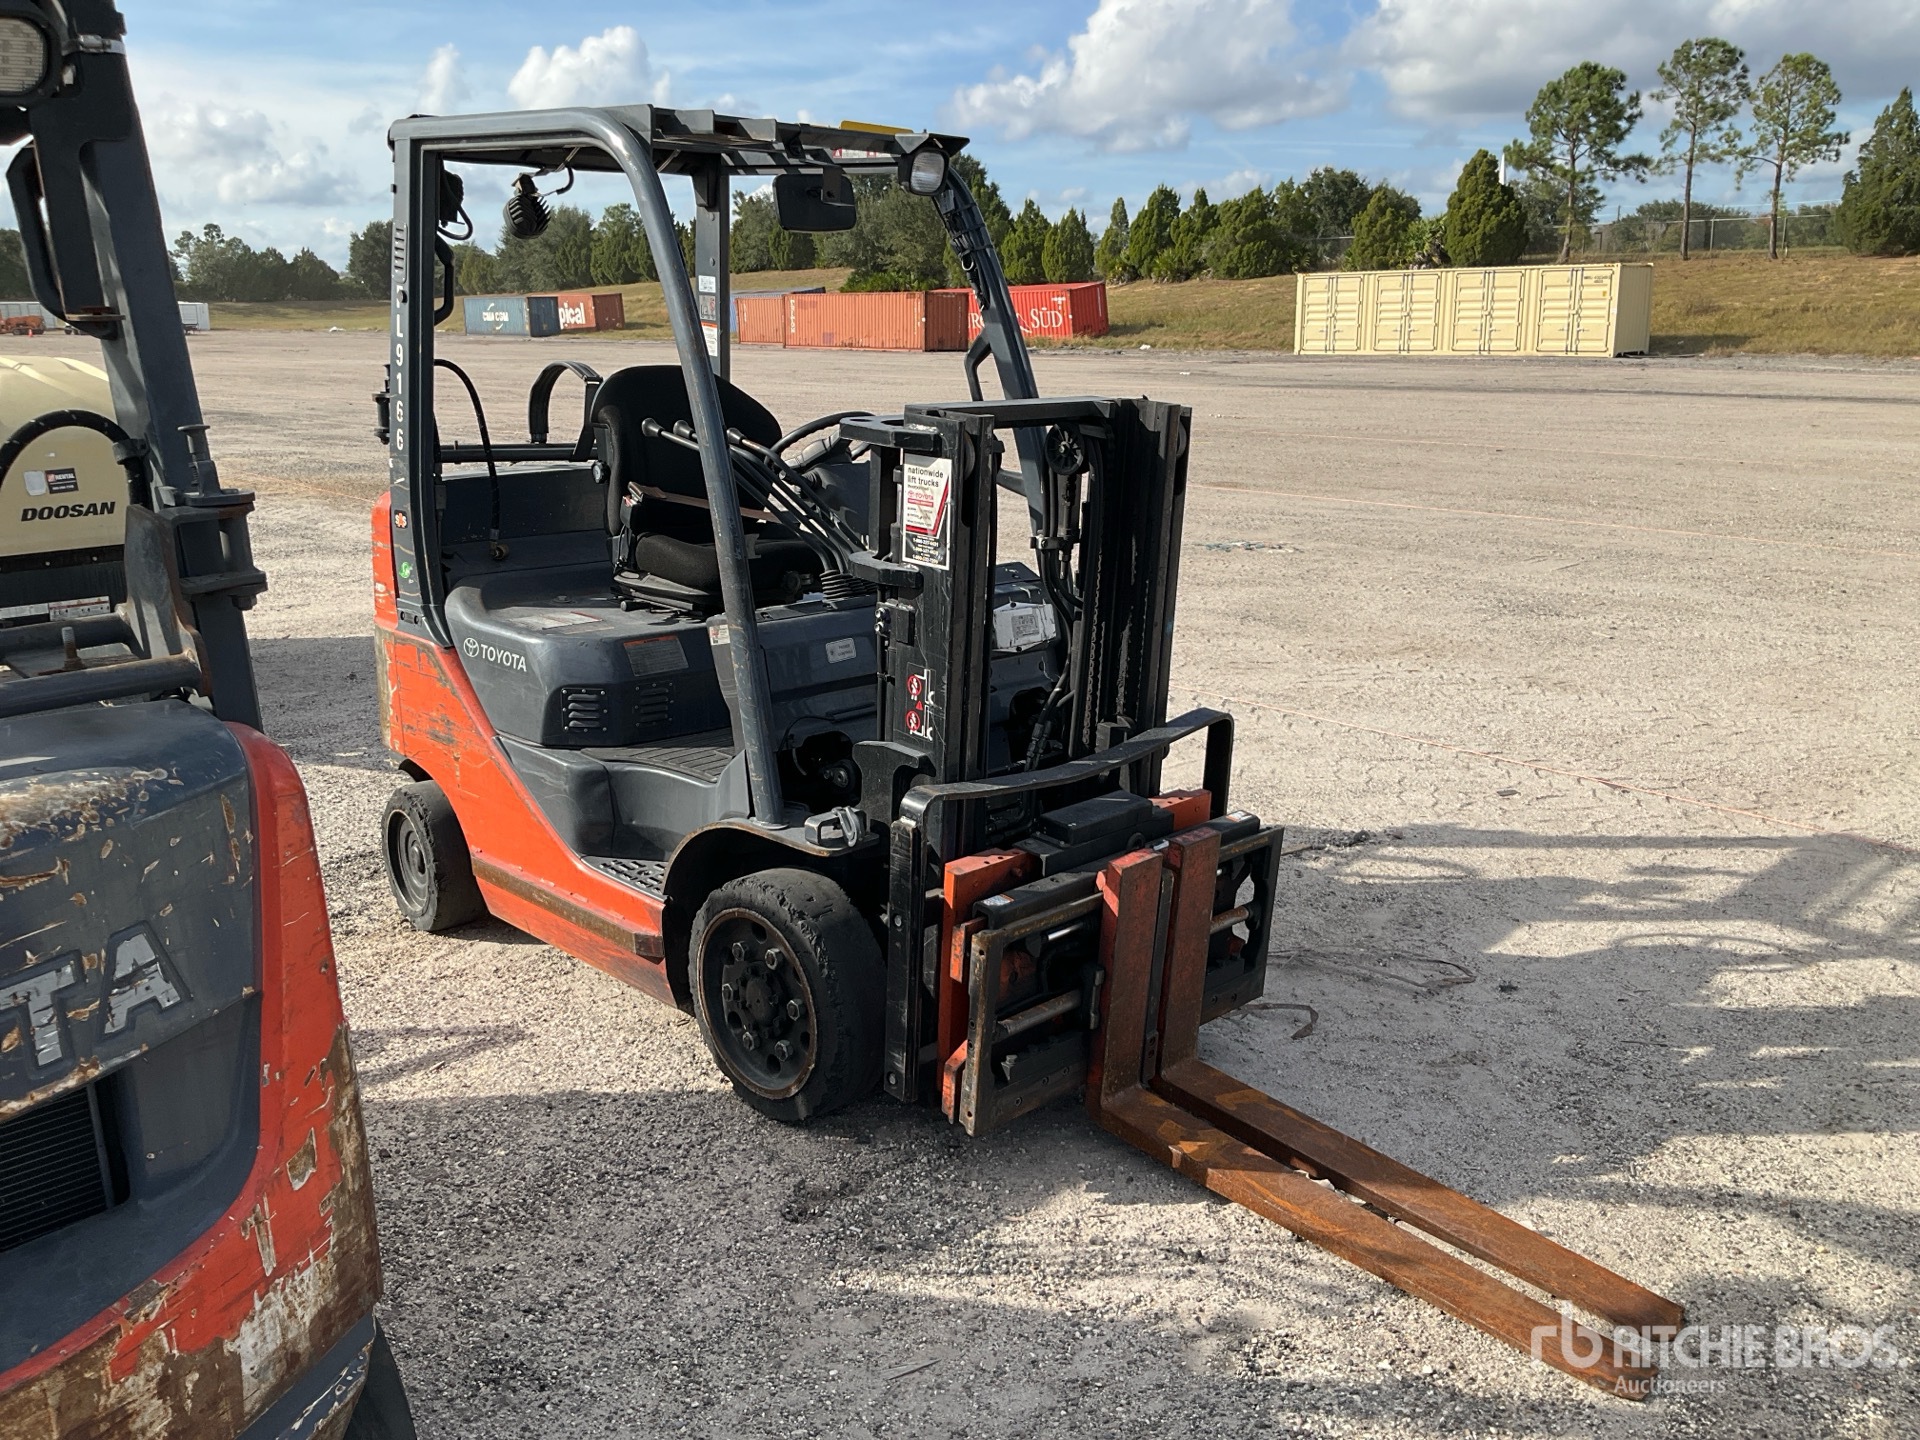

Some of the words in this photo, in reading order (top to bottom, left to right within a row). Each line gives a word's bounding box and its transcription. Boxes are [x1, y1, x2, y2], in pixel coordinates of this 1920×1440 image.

[482, 311, 494, 322] CMA
[495, 311, 509, 322] CGM
[1030, 306, 1063, 329] SÜD
[907, 467, 944, 479] nationwide
[907, 475, 917, 484] lift
[918, 477, 939, 488] trucks
[915, 492, 934, 501] TOYOTA
[21, 501, 116, 522] DOOSAN
[480, 643, 528, 673] TOYOTA
